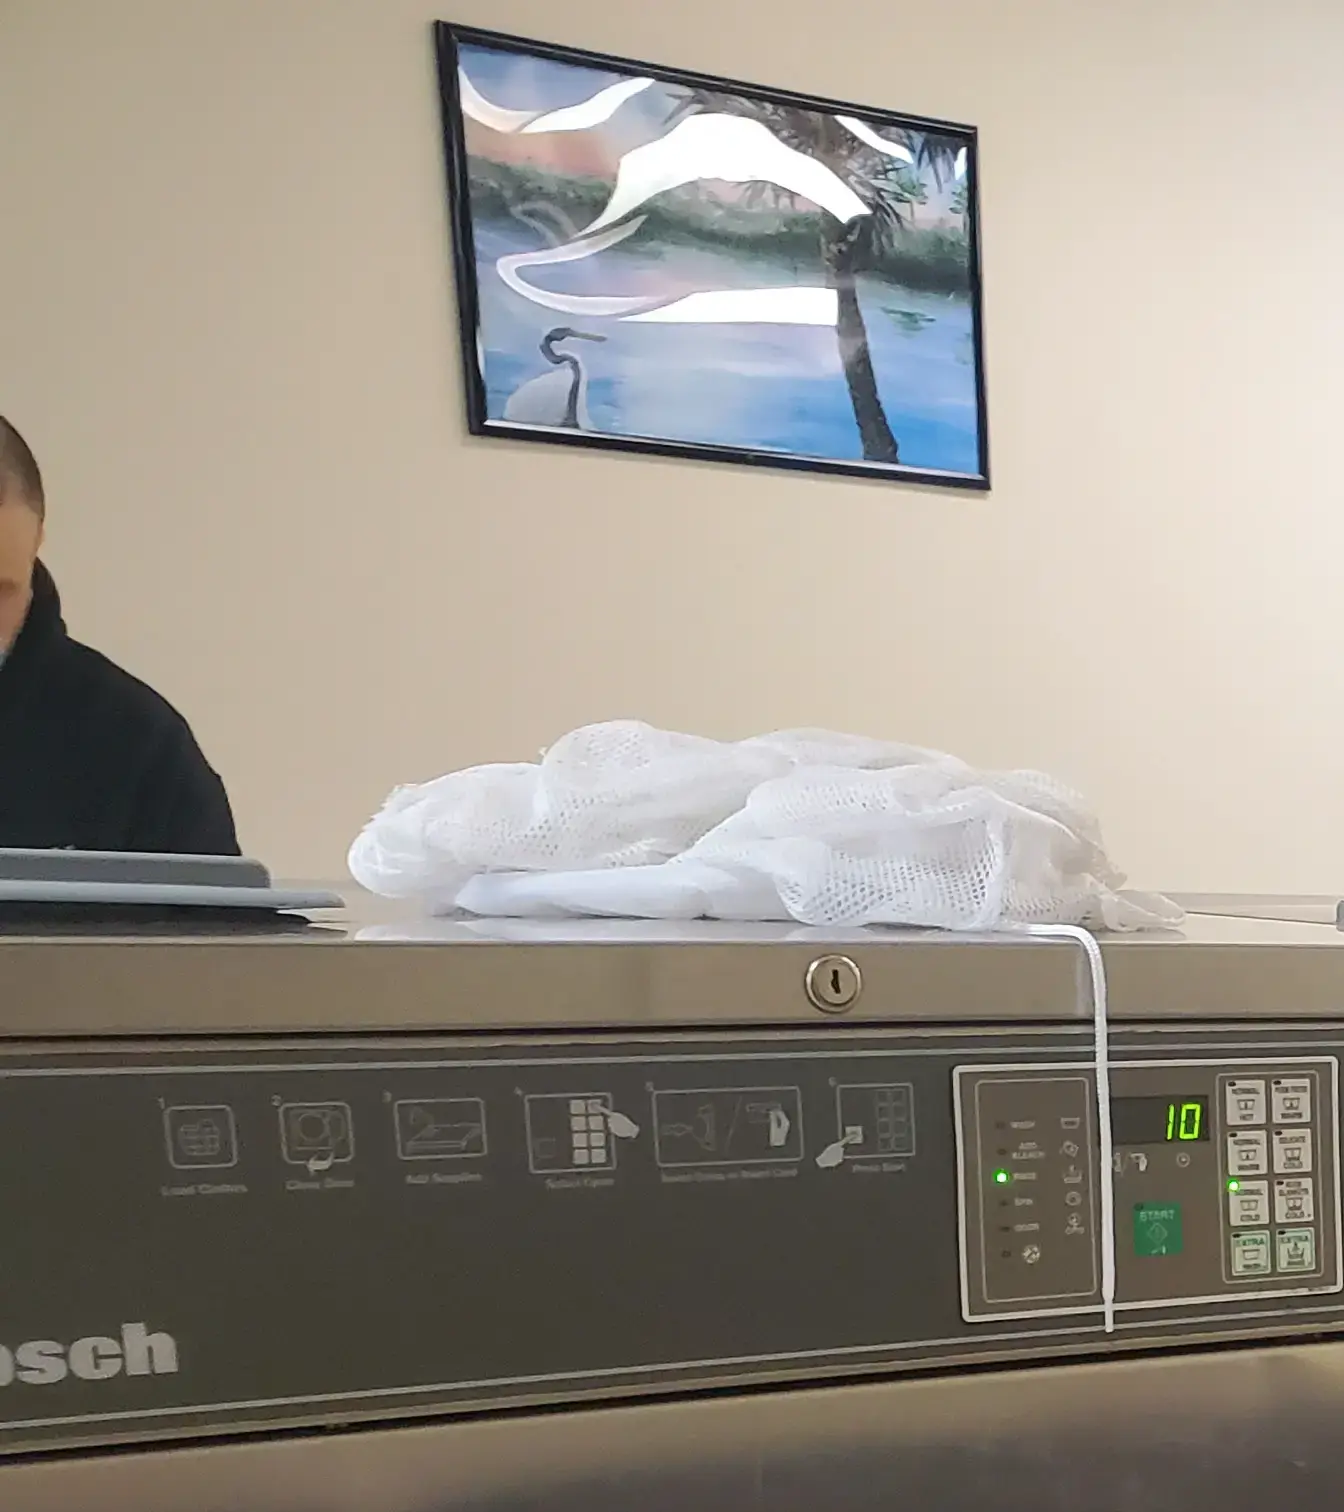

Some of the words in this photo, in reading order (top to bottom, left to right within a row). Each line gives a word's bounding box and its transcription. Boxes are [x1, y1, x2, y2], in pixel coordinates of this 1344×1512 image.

[1166, 1103, 1201, 1140] 10
[1139, 1209, 1175, 1221] START
[0, 1322, 178, 1386] sch
